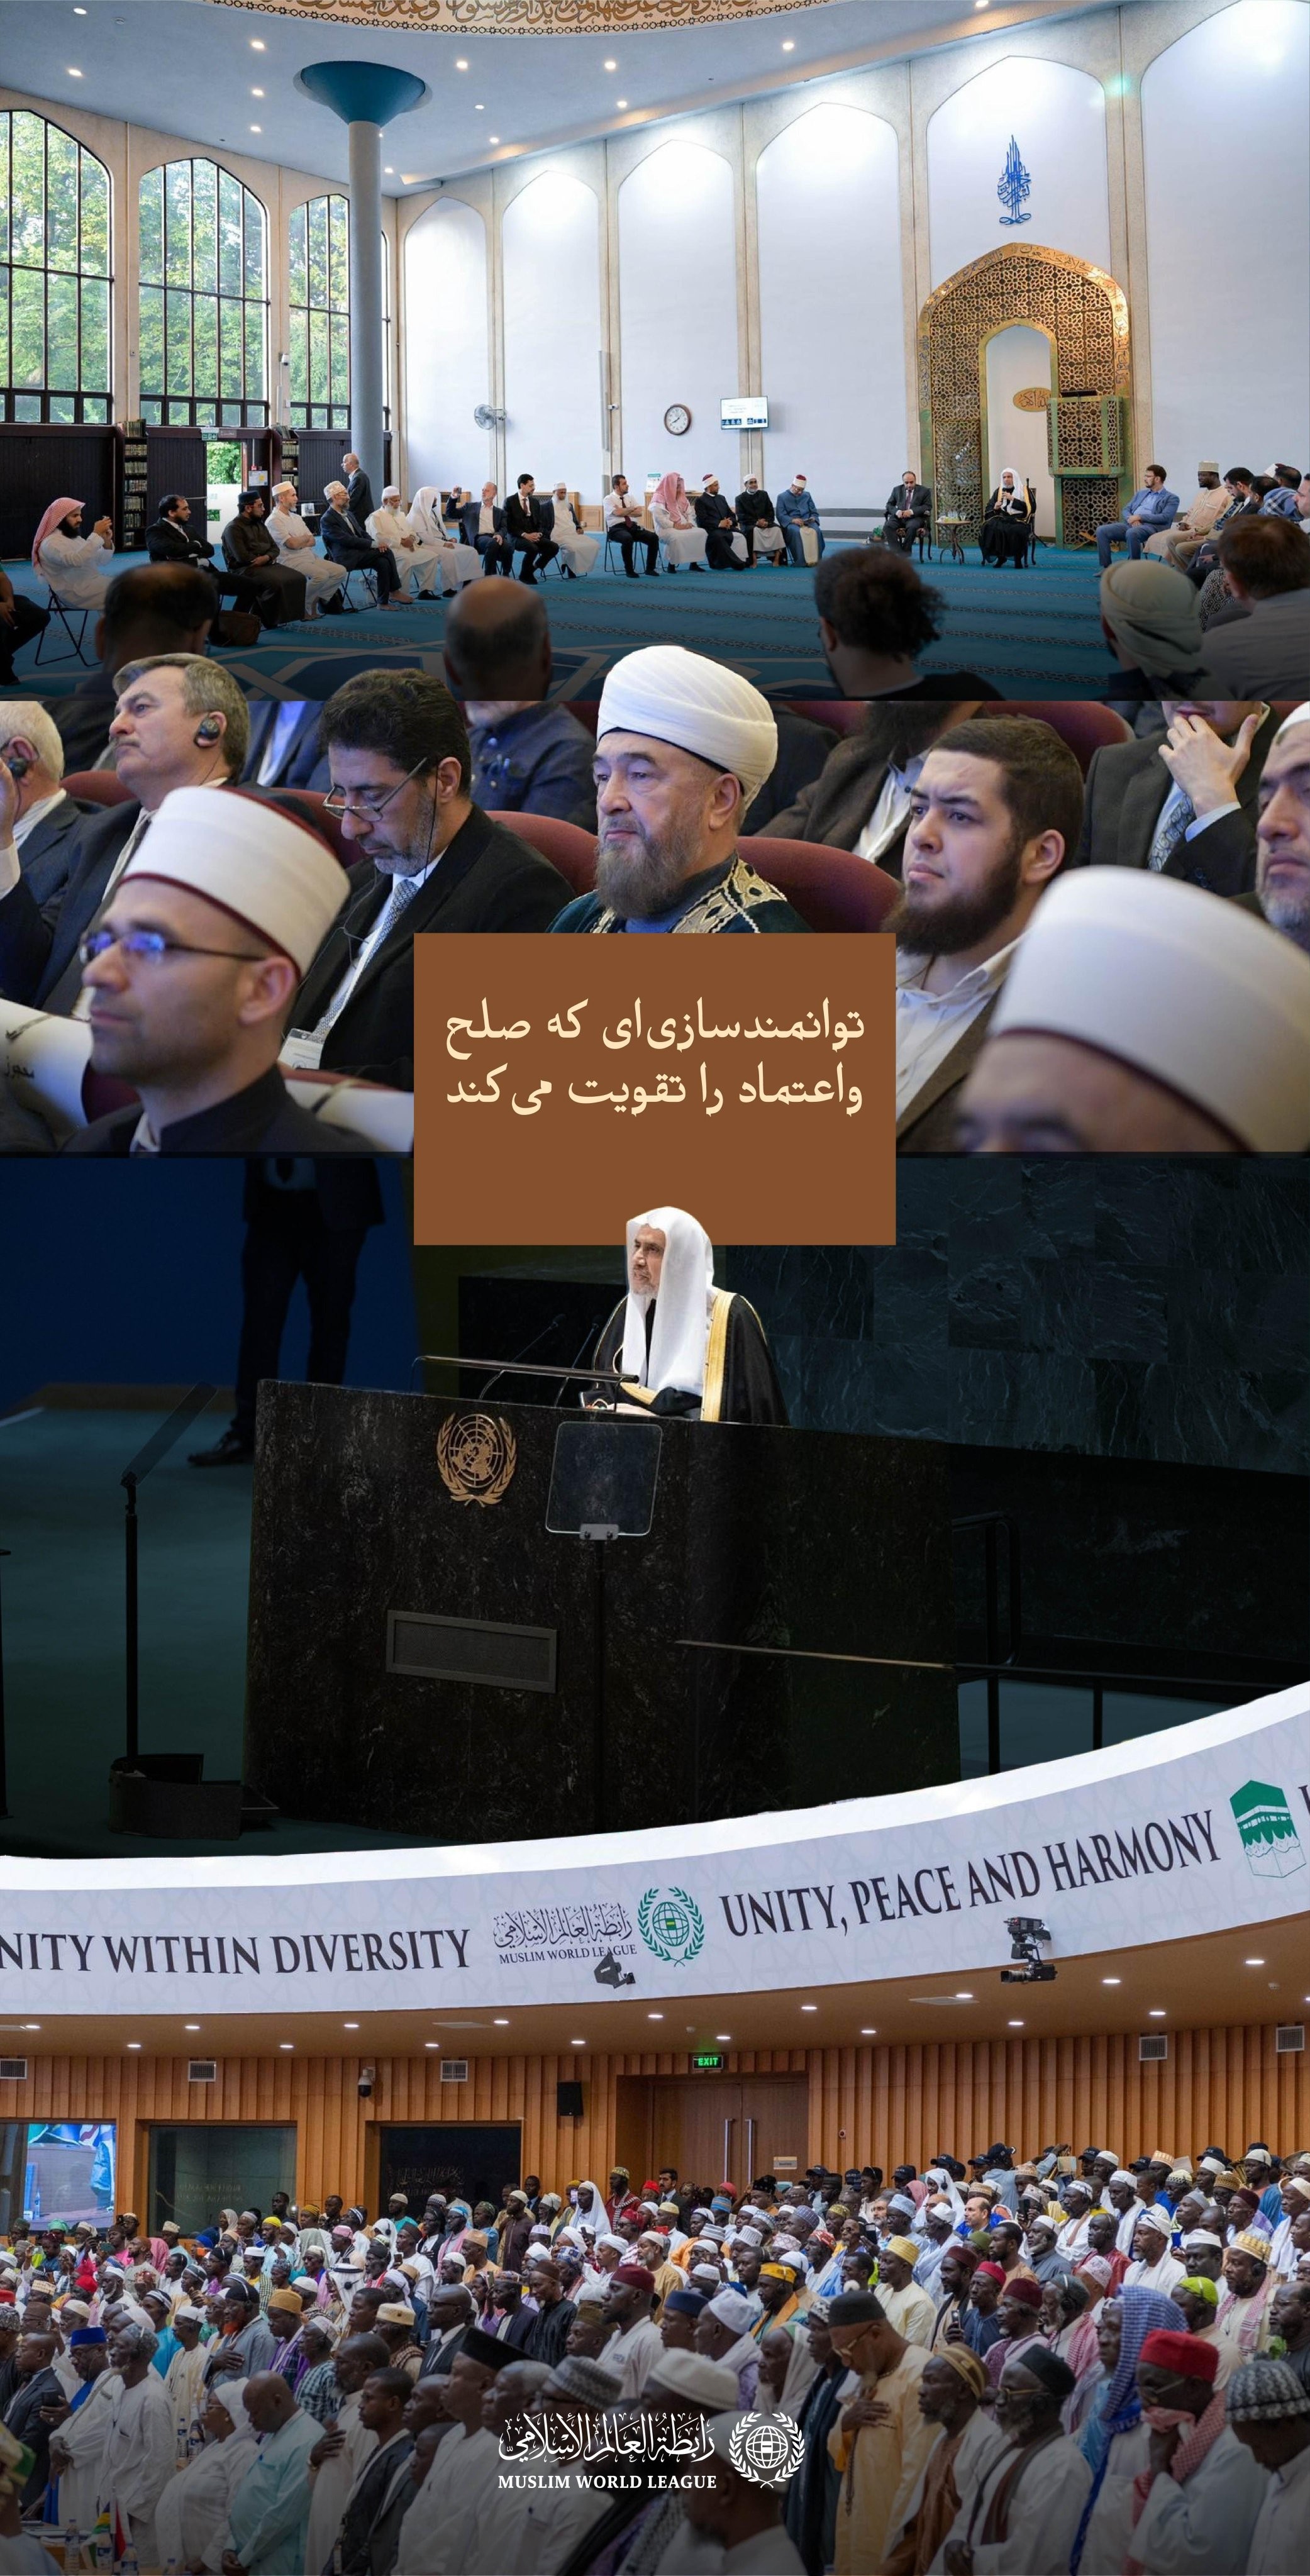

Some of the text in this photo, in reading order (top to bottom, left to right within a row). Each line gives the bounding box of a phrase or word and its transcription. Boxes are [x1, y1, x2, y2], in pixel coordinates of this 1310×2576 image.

[719, 1809, 1221, 1936] UNITY, PEACE AND HARMONY
[102, 1936, 260, 1974] WITHIN
[270, 1929, 470, 1974] DIVERSITY
[499, 1951, 545, 1964] MUSLIM
[547, 1948, 590, 1960] WORLD
[698, 2057, 718, 2066] EXIT
